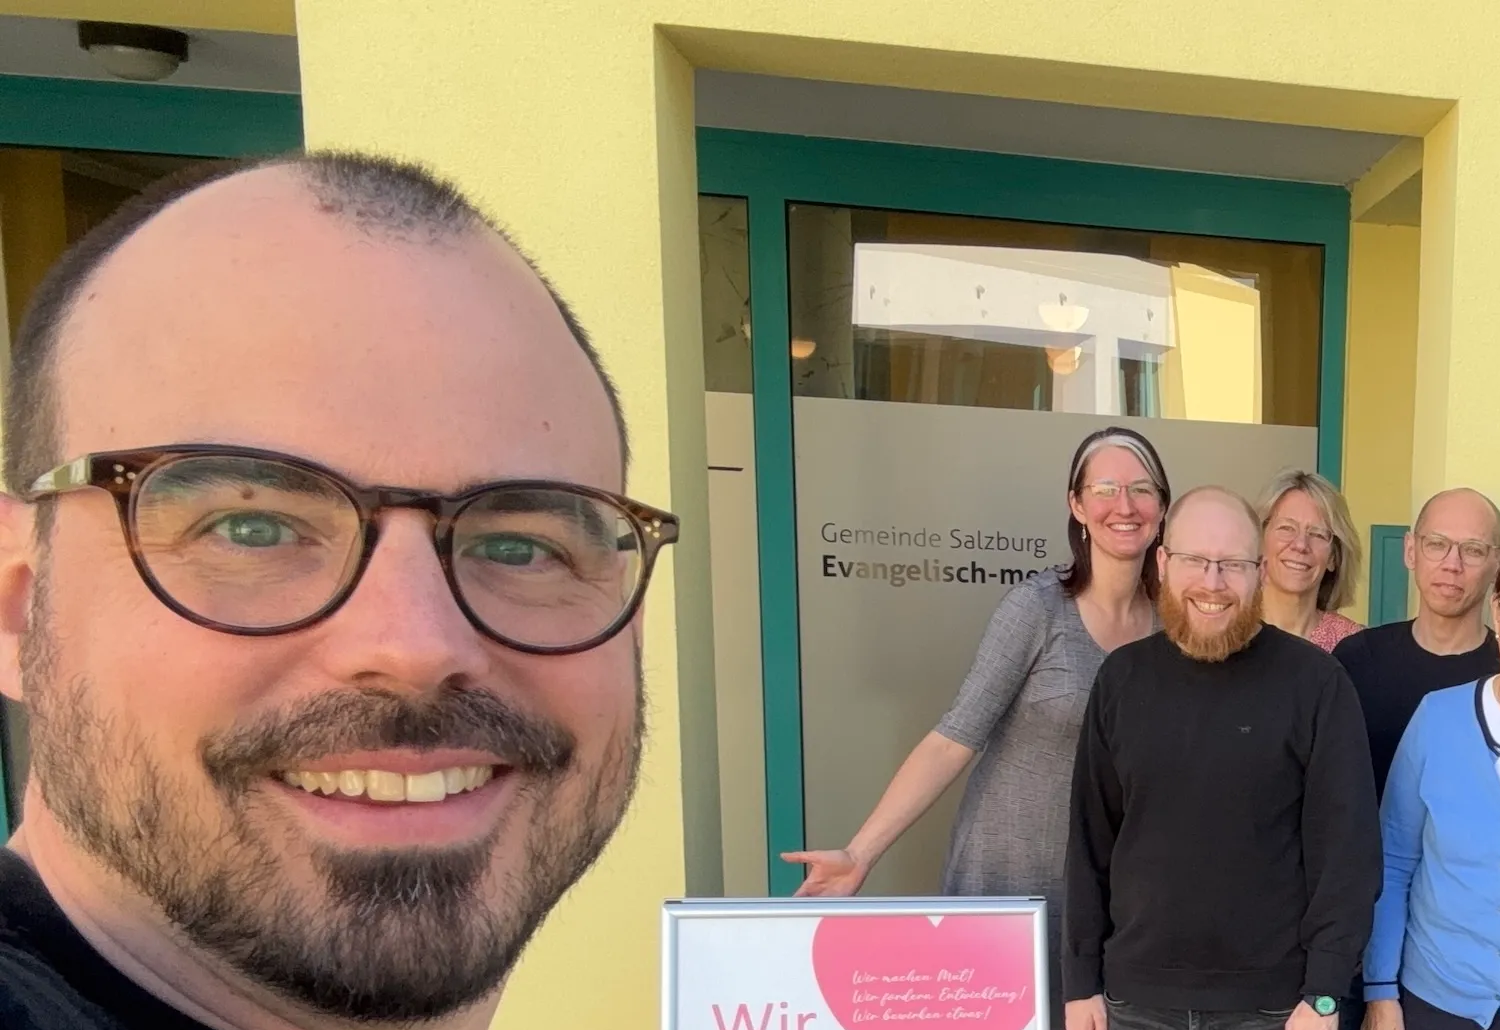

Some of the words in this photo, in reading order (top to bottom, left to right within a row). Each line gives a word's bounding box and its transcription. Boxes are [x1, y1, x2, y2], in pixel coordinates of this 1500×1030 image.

[821, 522, 942, 548] Gemeinde
[950, 528, 1047, 558] Salzburg
[822, 554, 1048, 588] Evangelisch-me
[852, 969, 878, 985] Wir
[882, 969, 932, 983] machen
[937, 968, 976, 983] Mut!
[852, 989, 878, 1004] Wir
[852, 1008, 878, 1023] Wir
